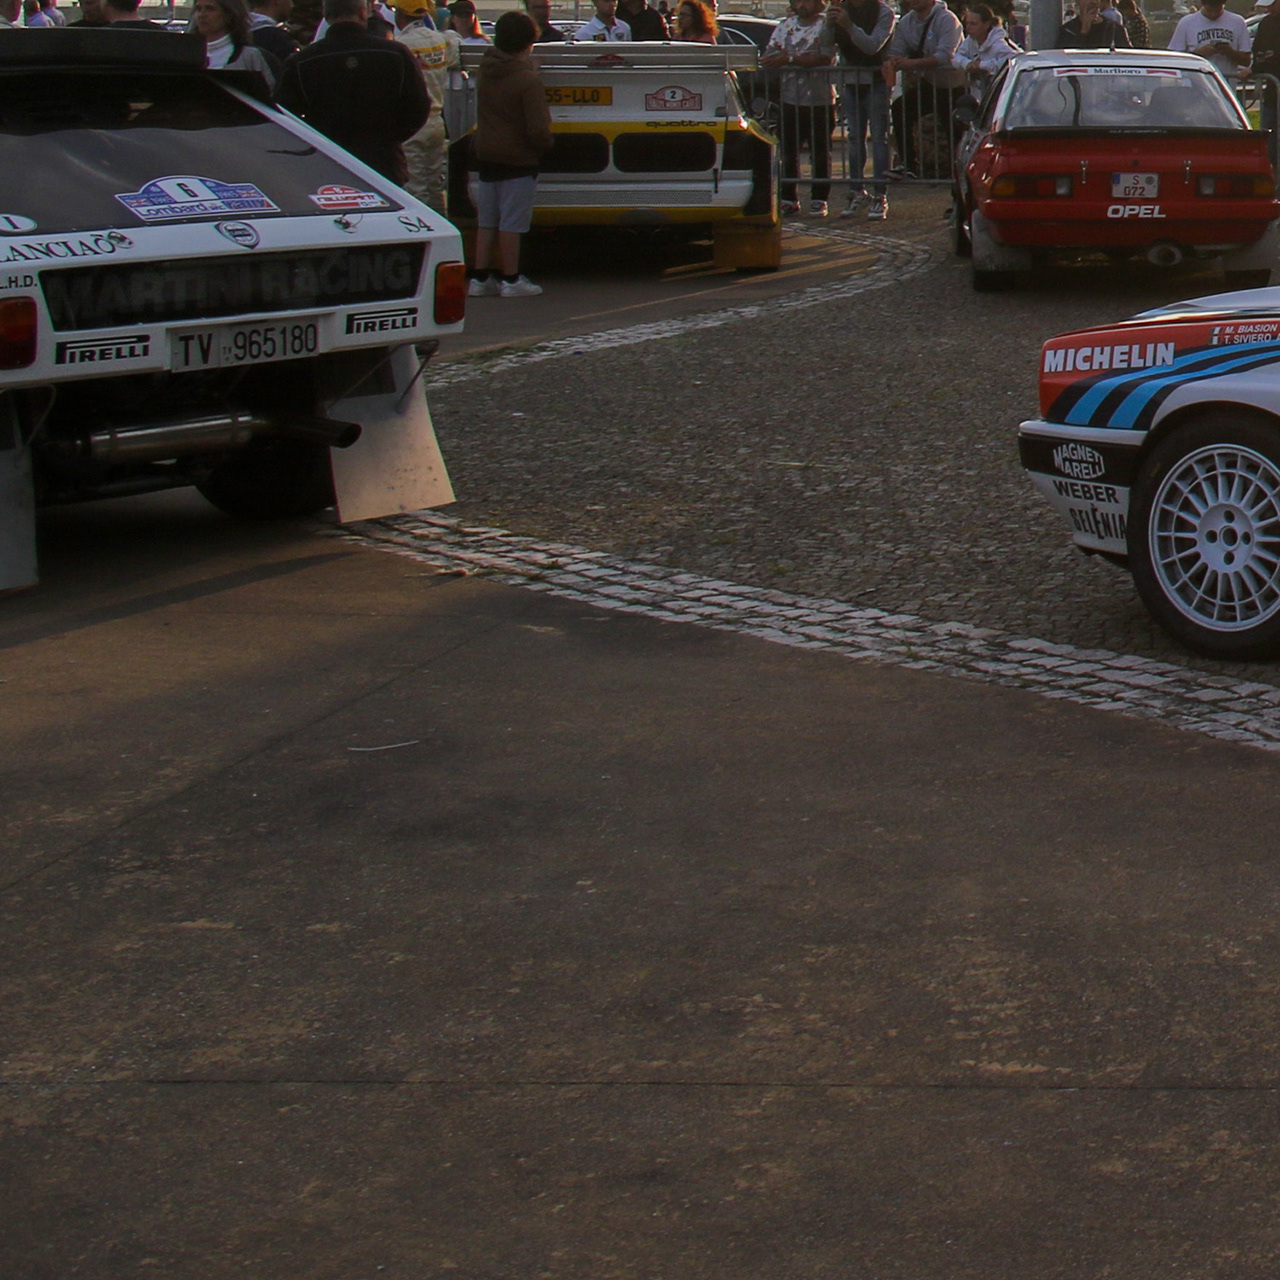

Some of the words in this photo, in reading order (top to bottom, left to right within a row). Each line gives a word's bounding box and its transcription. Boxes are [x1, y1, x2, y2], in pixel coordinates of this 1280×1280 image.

[1197, 28, 1234, 44] CONVERSE
[670, 90, 677, 99] 2
[646, 120, 717, 128] quattro
[1133, 176, 1139, 184] S
[176, 183, 198, 197] 6
[1107, 205, 1166, 218] OPEL
[397, 216, 434, 232] S4
[261, 250, 412, 302] RACING
[346, 307, 418, 334] PIRELLI
[1237, 324, 1279, 333] BIASION
[179, 333, 213, 366] TV
[234, 323, 318, 360] 965180
[1234, 333, 1272, 344] SIVIERO
[56, 334, 150, 365] PIRELLI
[1044, 342, 1175, 373] MICHELIN
[1053, 480, 1119, 504] WEBER
